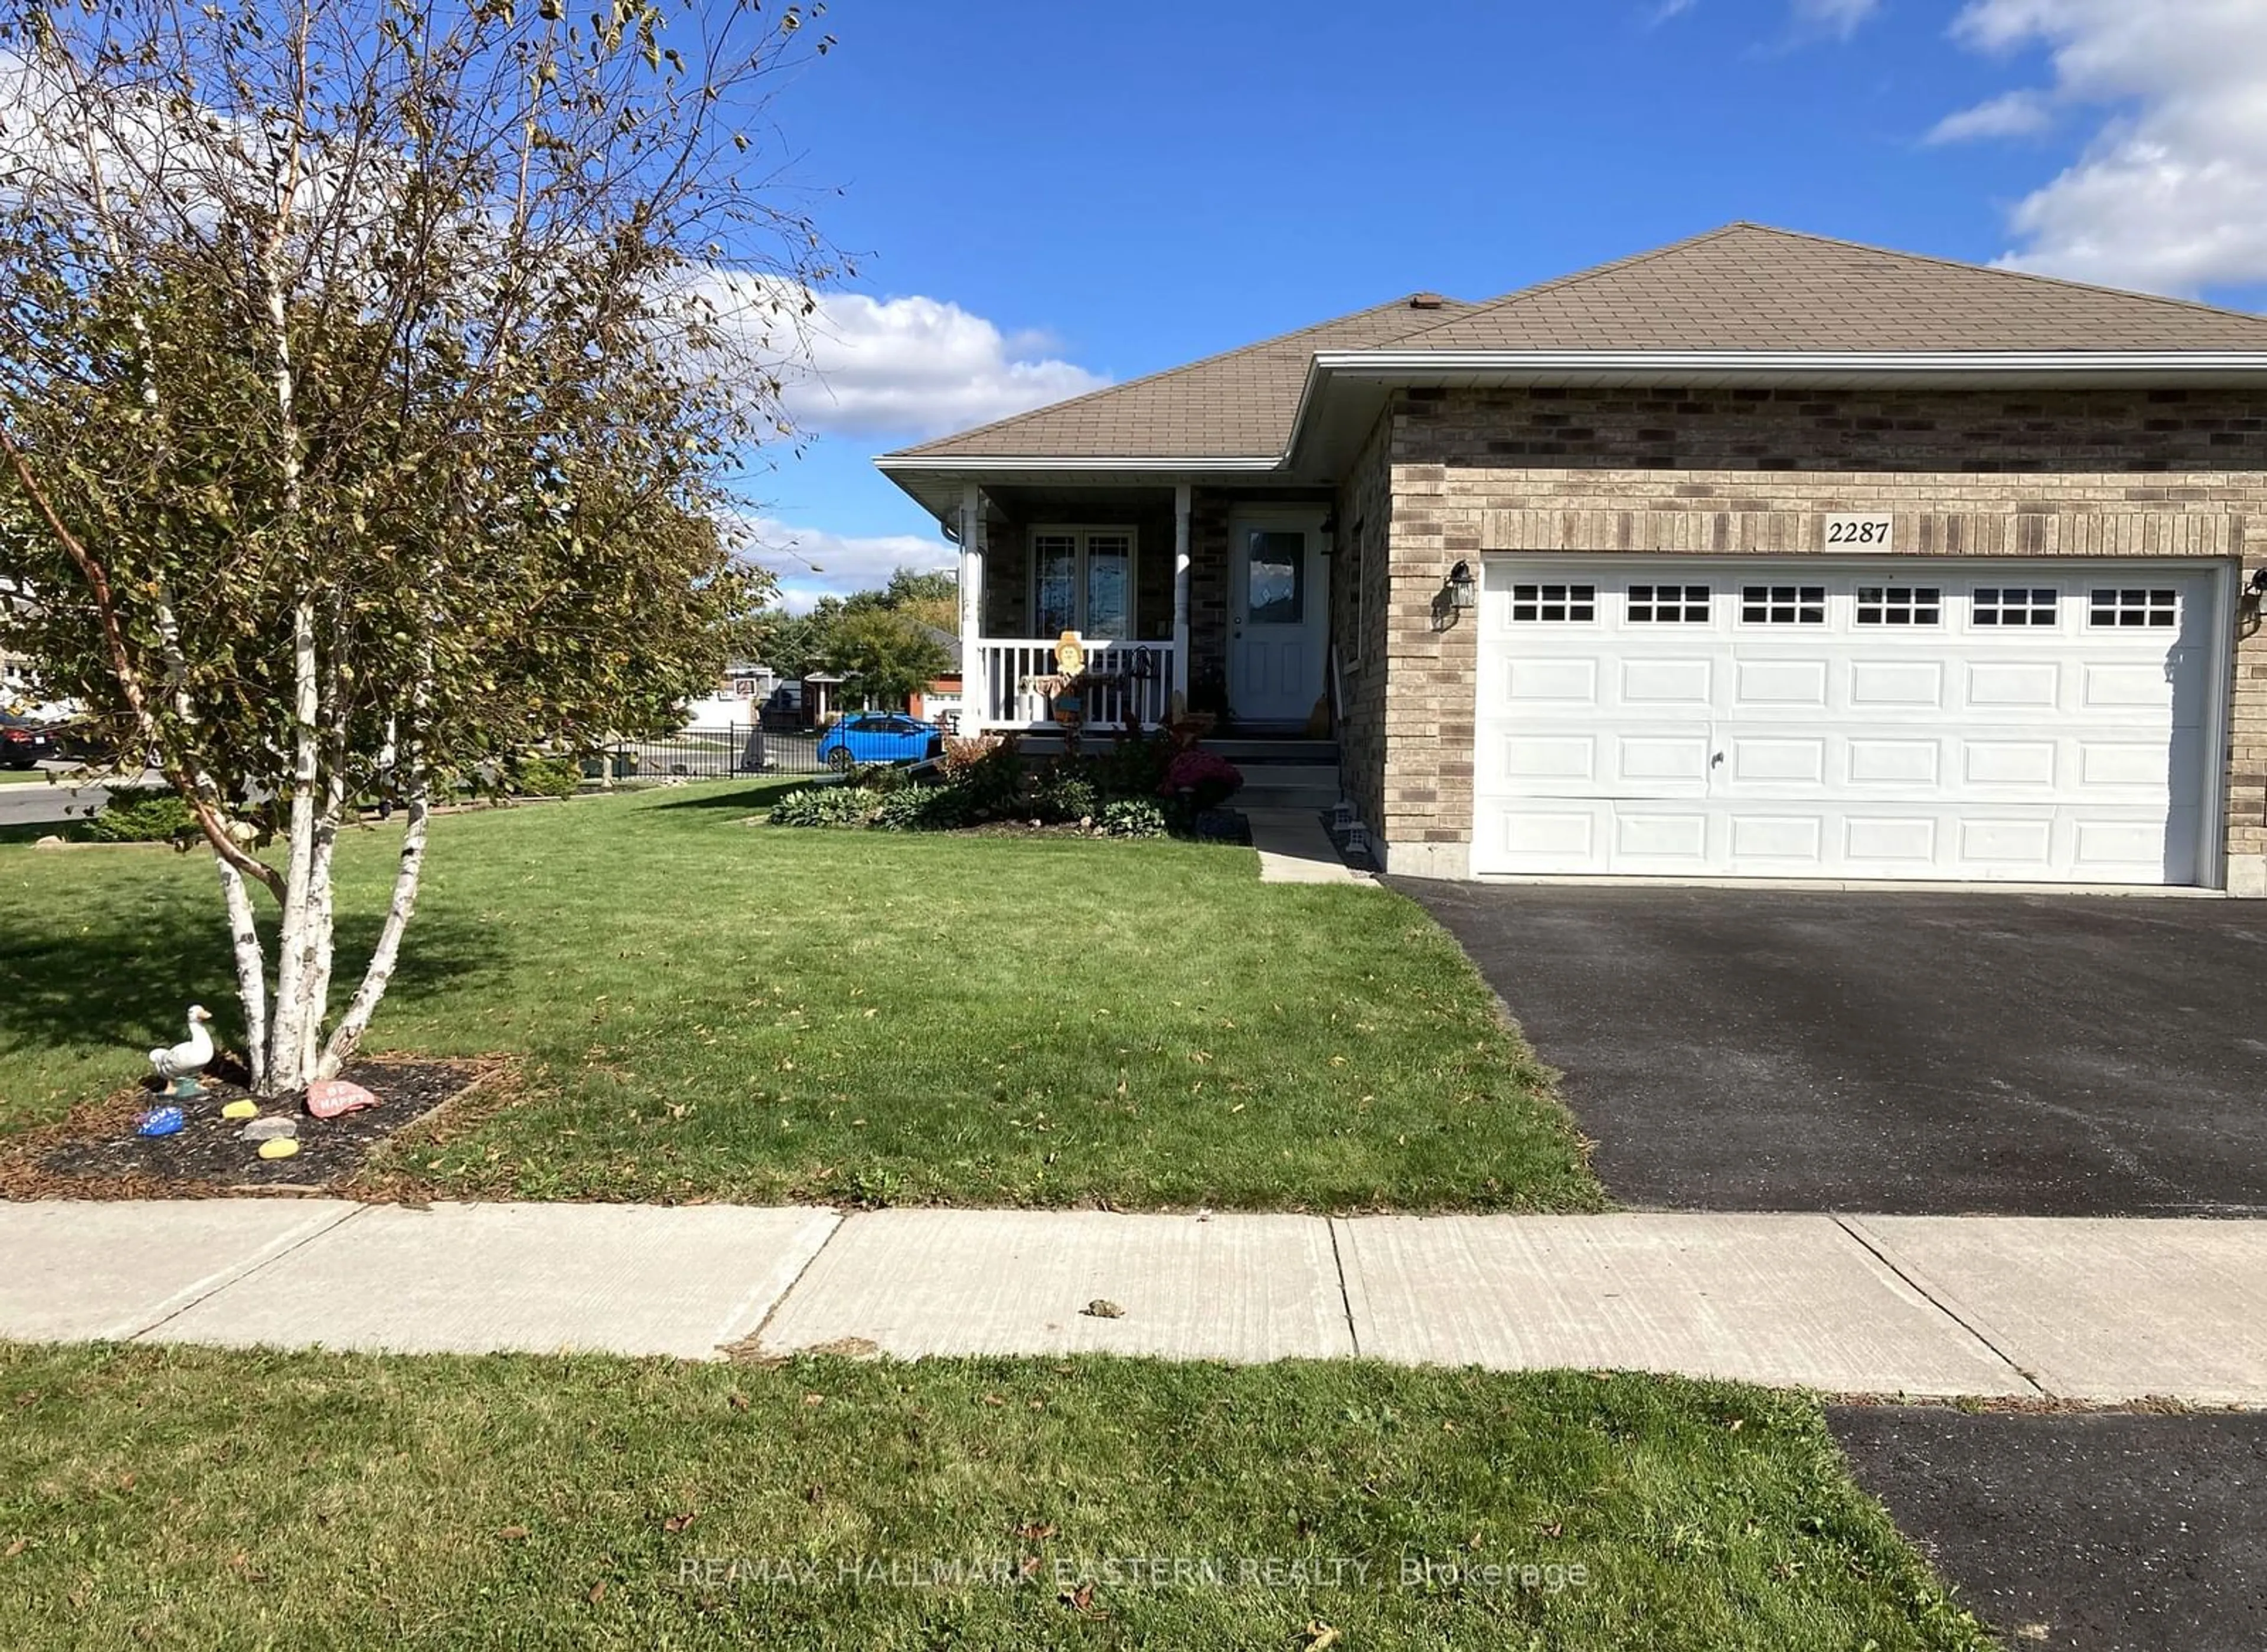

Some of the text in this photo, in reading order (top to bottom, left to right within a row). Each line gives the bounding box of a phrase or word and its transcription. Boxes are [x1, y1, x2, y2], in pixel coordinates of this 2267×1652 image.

[1828, 522, 1889, 543] 2287
[319, 1094, 364, 1110] HAPPY
[142, 1106, 179, 1129] LOVE
